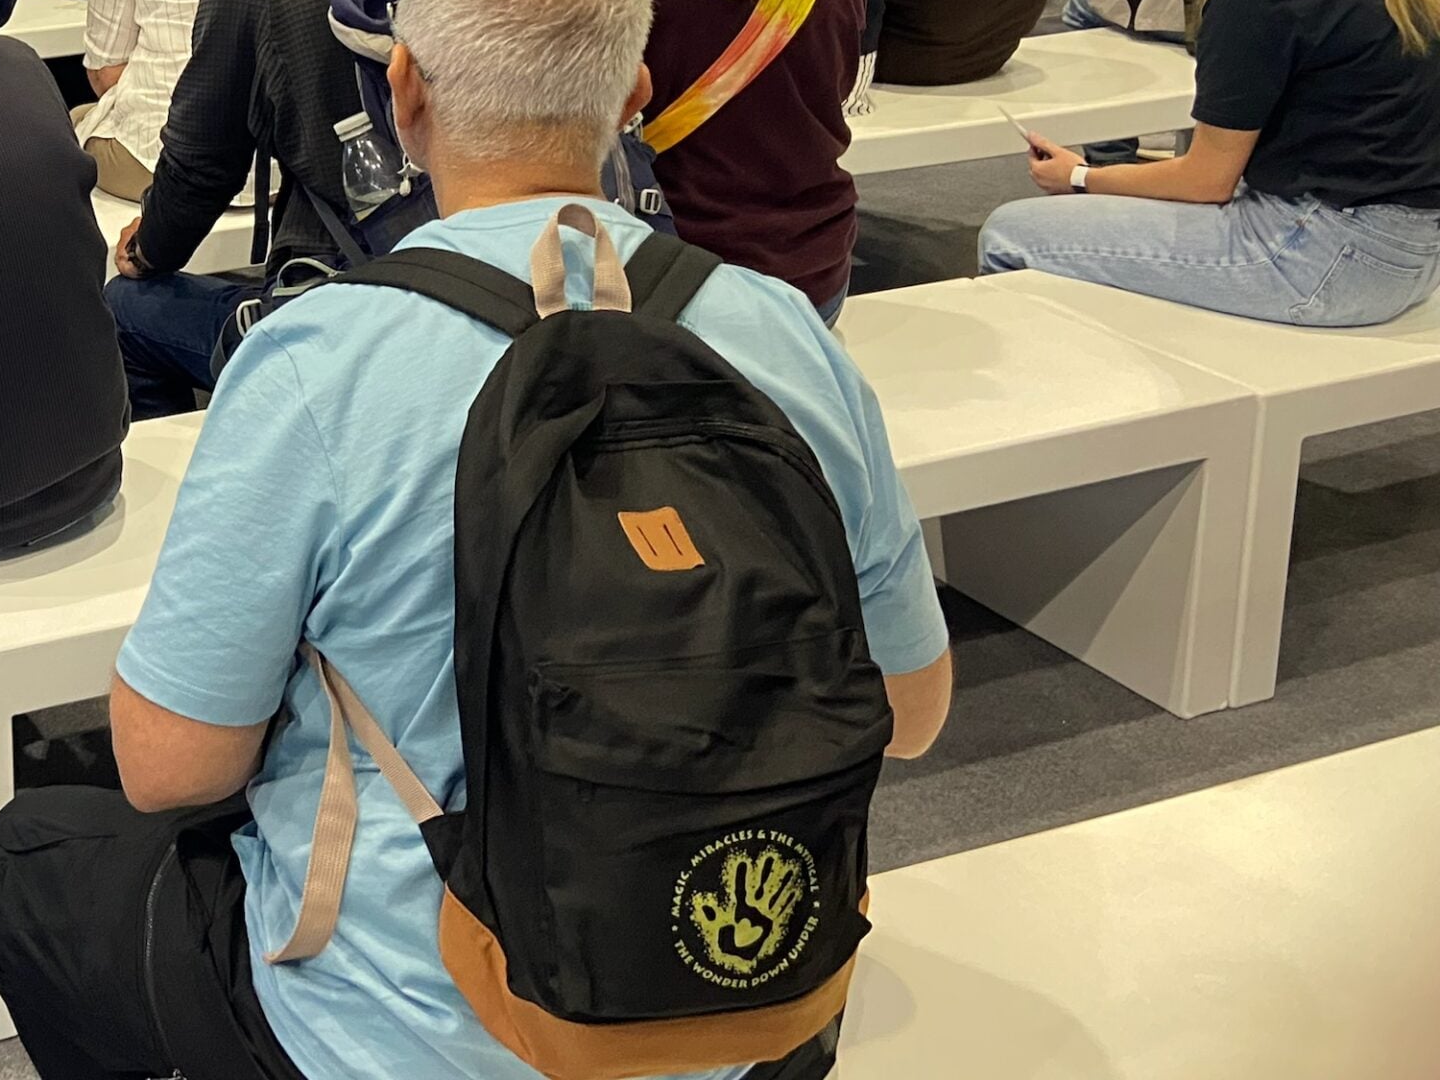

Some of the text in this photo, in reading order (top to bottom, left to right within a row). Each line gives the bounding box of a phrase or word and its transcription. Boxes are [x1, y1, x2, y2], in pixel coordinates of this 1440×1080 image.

[671, 829, 820, 917] MAGIC, MIRACLES & THE MYSTICAL
[674, 916, 820, 988] THE WONDER DOWN UNDER
